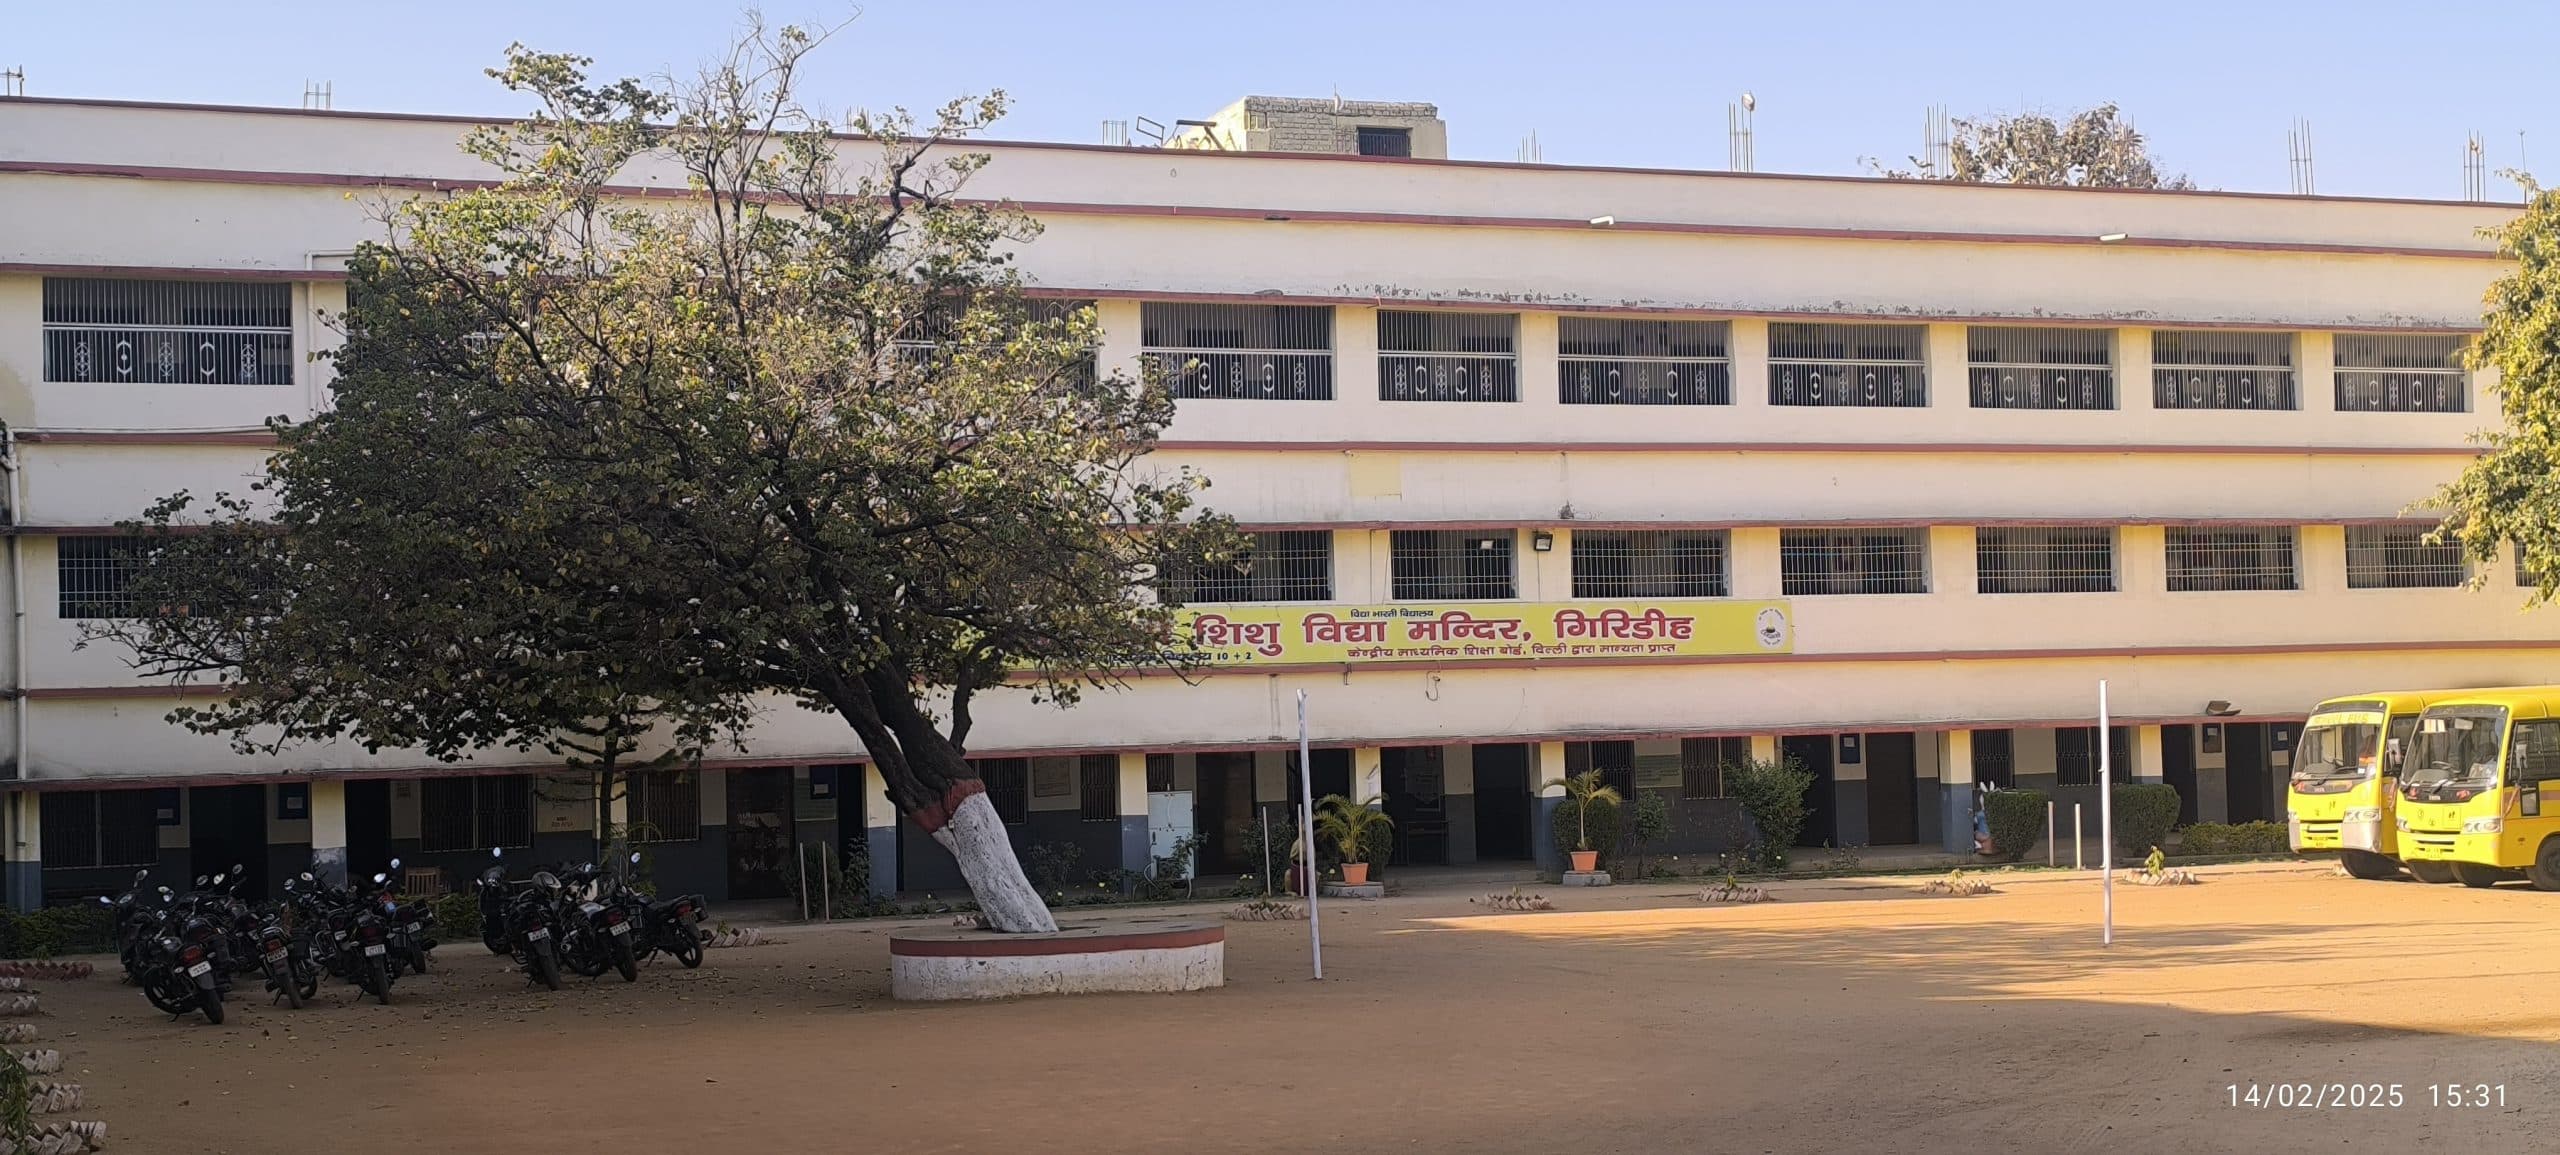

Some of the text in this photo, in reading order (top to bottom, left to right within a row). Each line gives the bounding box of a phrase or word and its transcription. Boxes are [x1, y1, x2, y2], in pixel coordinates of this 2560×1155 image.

[1372, 608, 1397, 618] भारती
[1400, 607, 1433, 617] विद्यालय
[1194, 612, 1282, 656] शिशु
[1302, 612, 1387, 643] विद्या
[1407, 610, 1532, 642] मन्दिर,
[1553, 608, 1694, 640] गिरिडीह
[1216, 652, 1228, 661] 10
[1245, 651, 1252, 660] 2
[1398, 644, 1459, 657] माध्यमिक
[1463, 644, 1494, 656] शिक्षा
[1532, 642, 1567, 655] दिल्ली
[1571, 643, 1595, 655] द्वारा
[1599, 644, 1644, 654] मान्यता
[1648, 643, 1676, 654] प्राप्त
